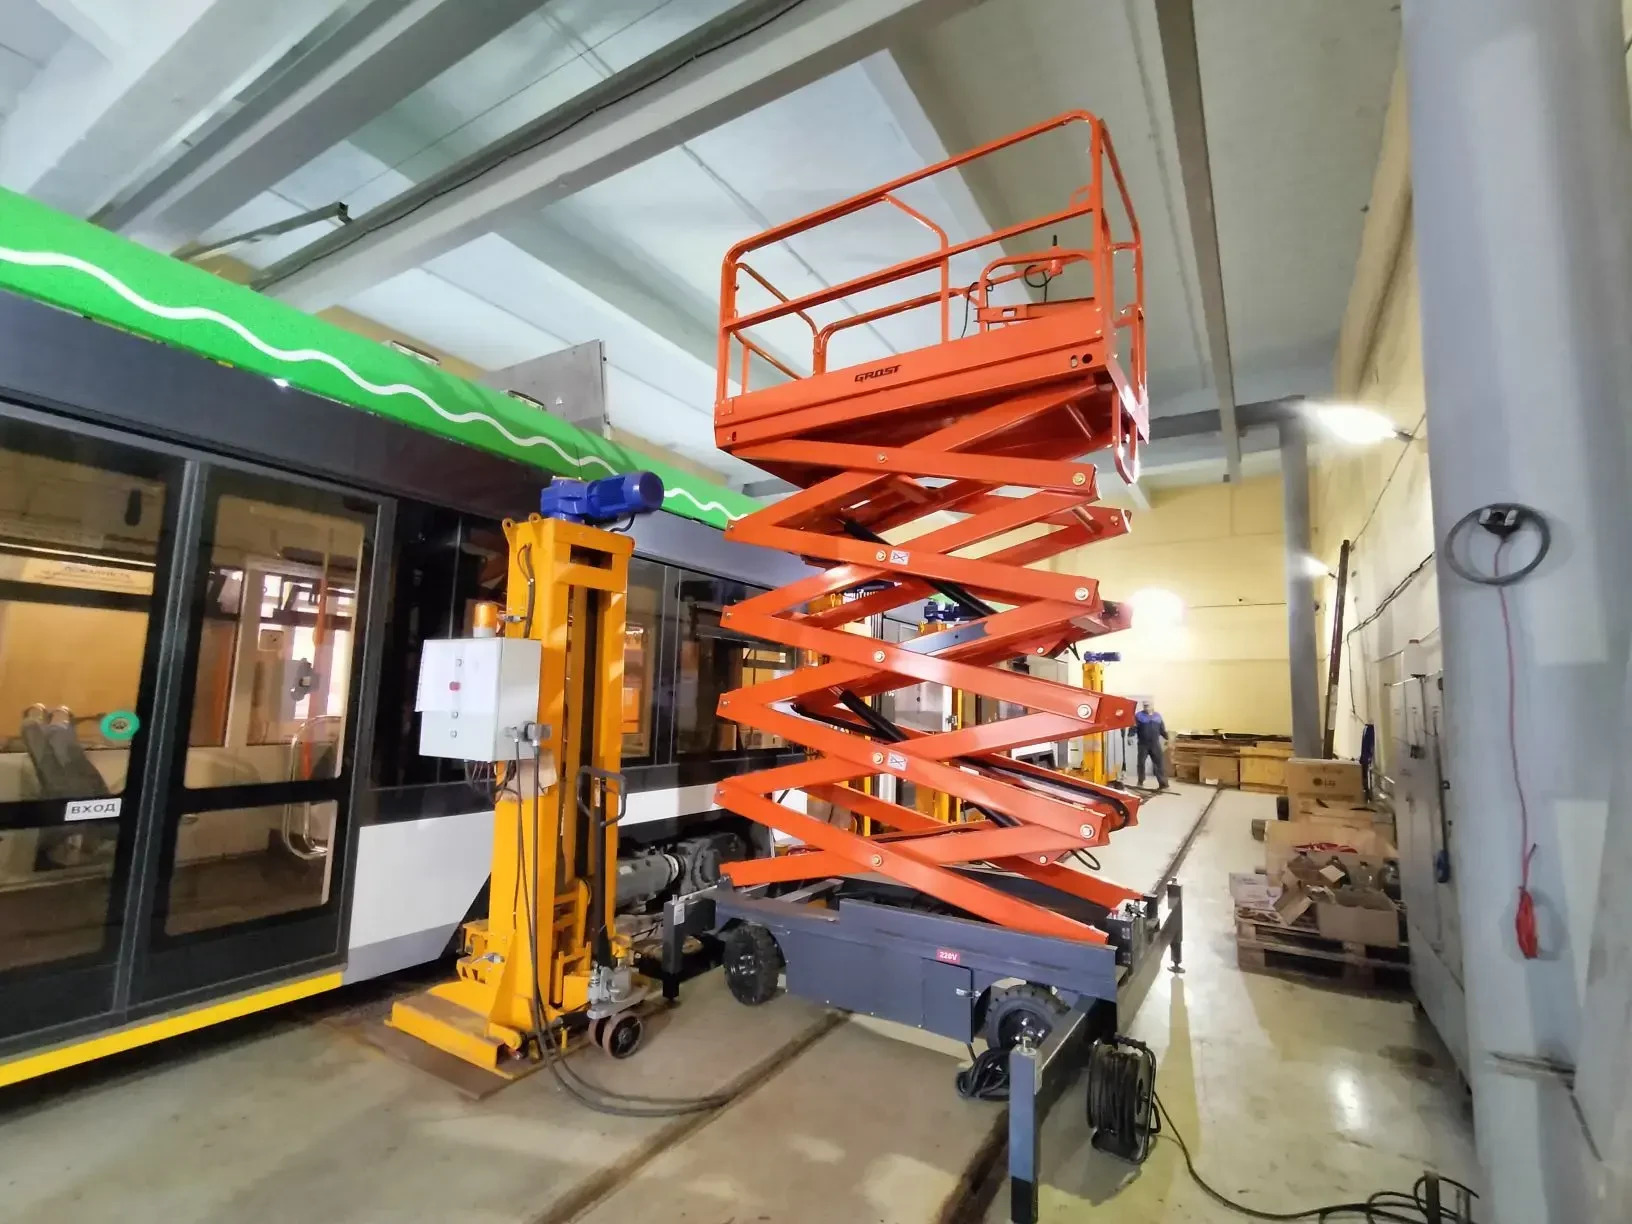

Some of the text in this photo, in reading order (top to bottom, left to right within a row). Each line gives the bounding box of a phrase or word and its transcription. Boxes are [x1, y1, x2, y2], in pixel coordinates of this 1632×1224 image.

[854, 364, 902, 383] GROST
[71, 803, 115, 815] ВХОД
[939, 951, 958, 961] 220V
